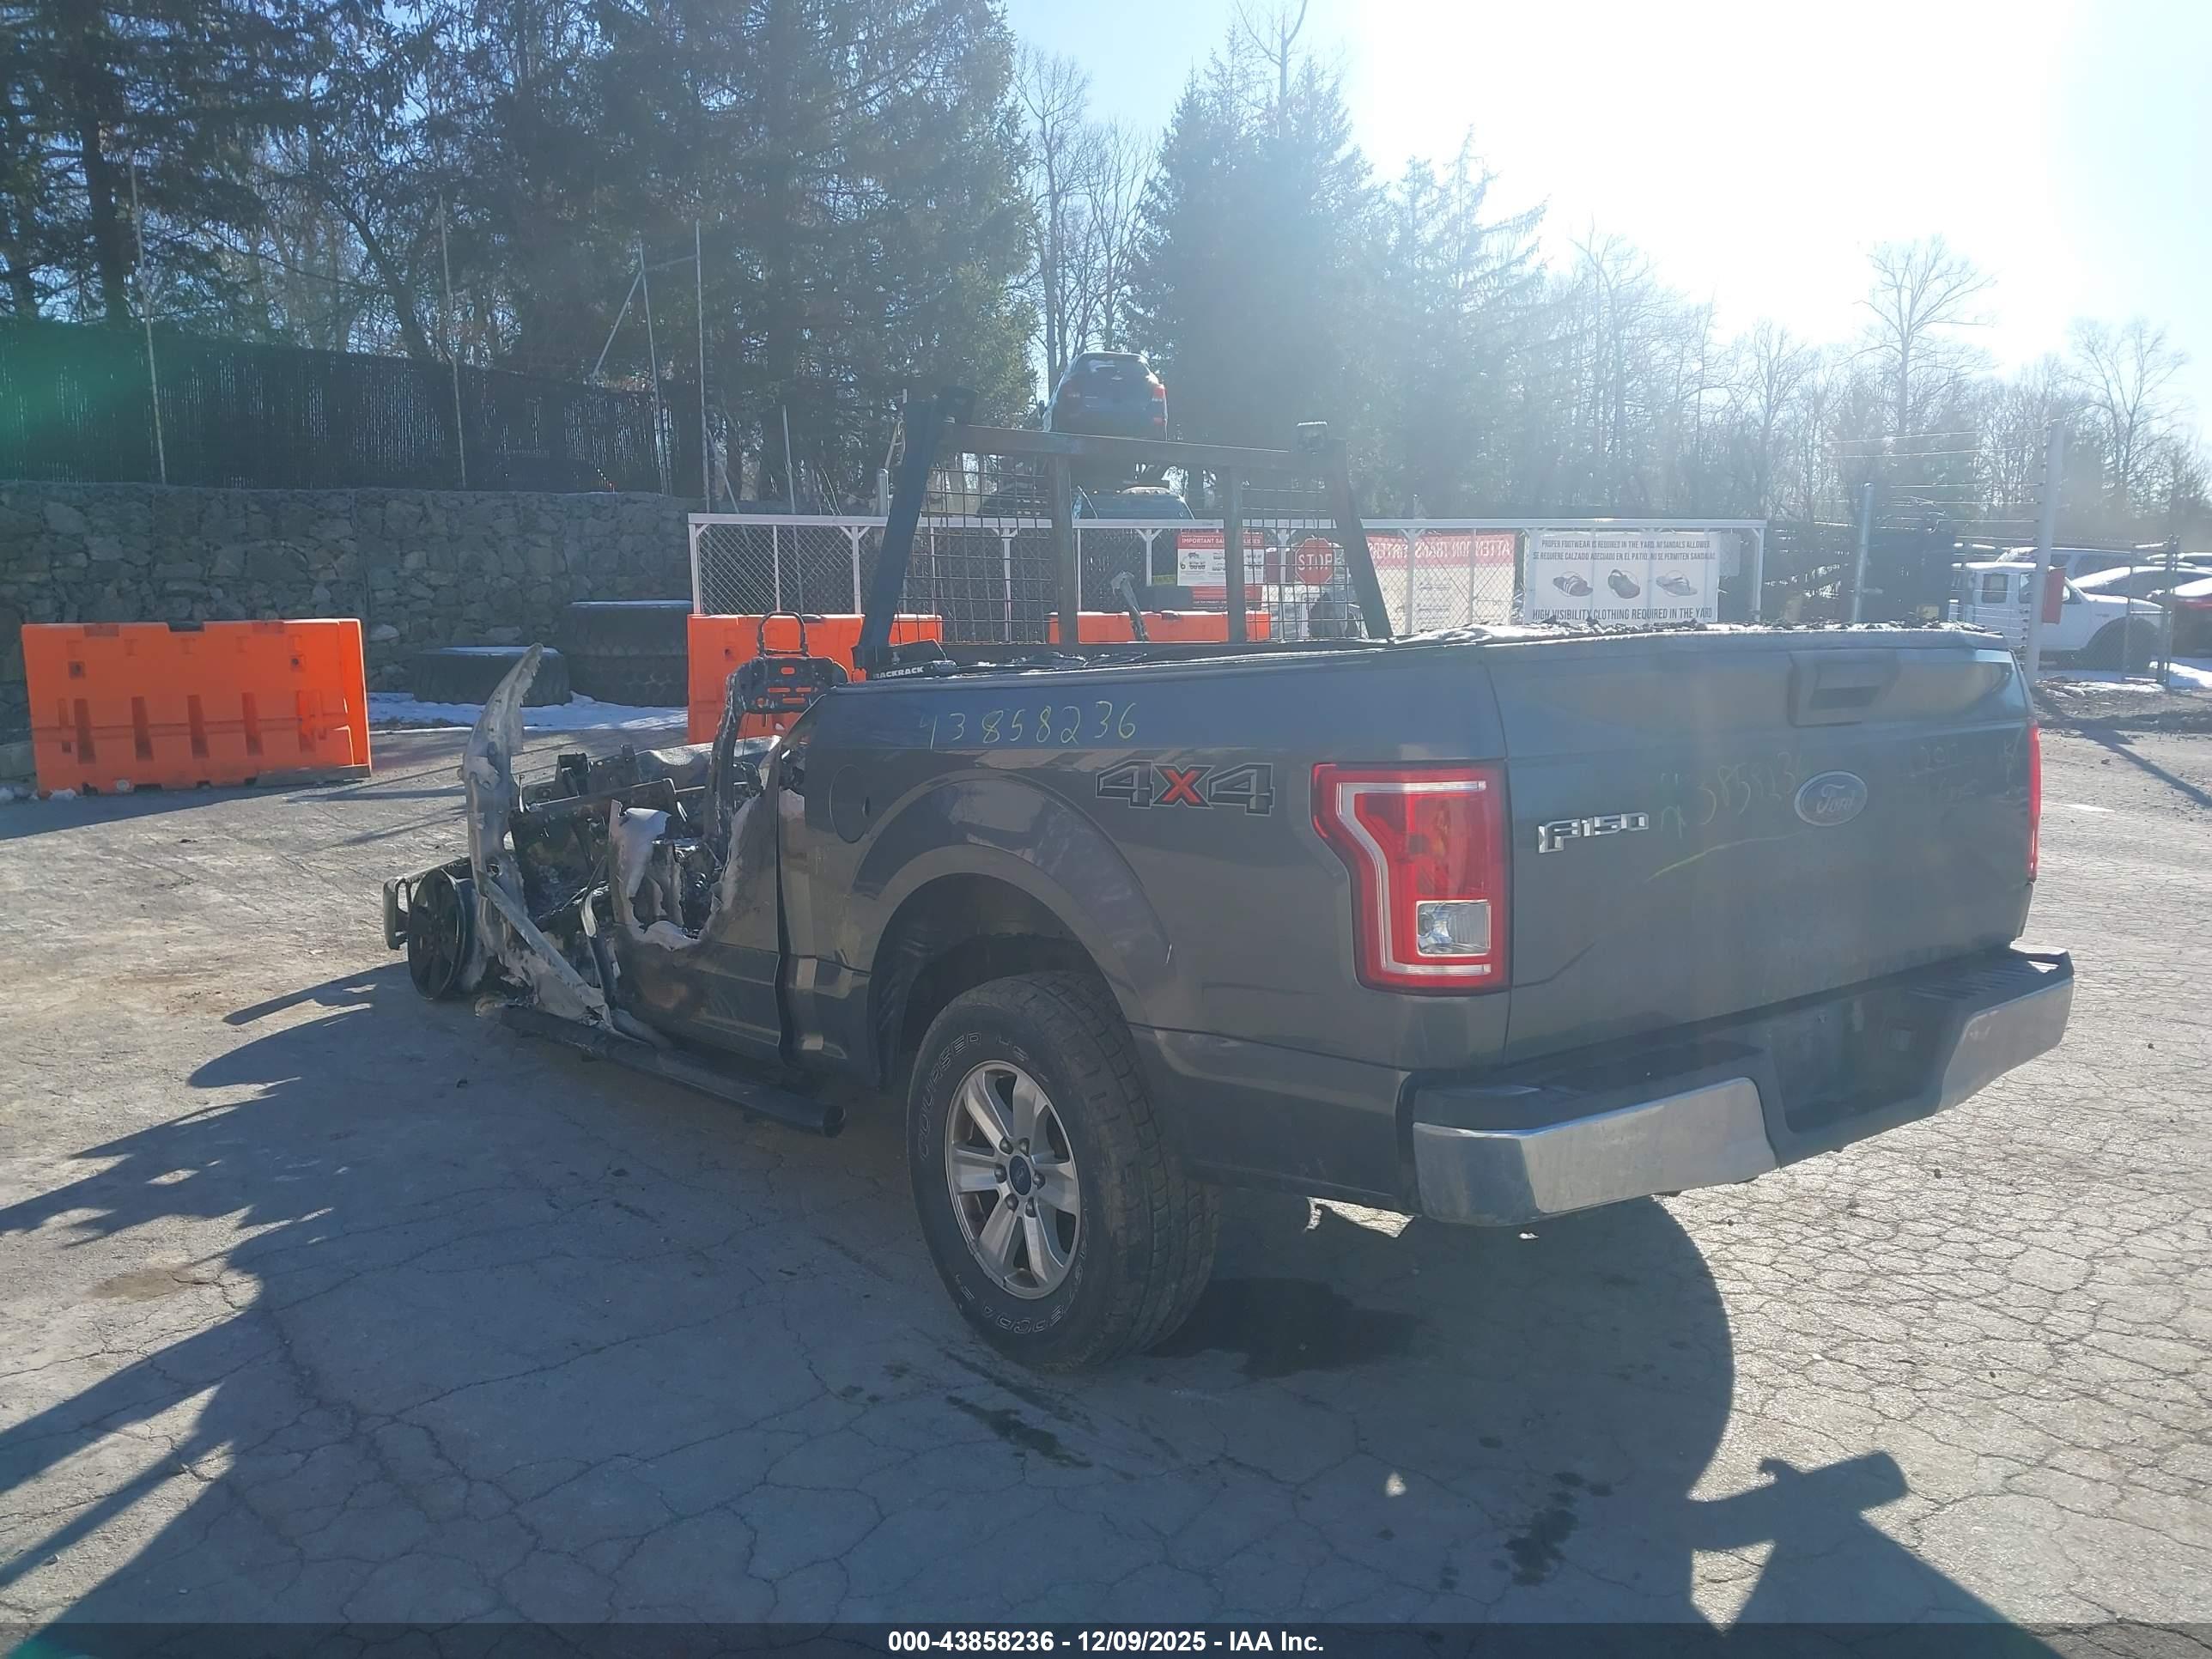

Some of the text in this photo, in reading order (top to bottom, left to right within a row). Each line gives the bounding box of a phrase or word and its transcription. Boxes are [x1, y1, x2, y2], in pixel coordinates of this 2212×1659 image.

[1598, 540, 1620, 549] REQUIRED
[1297, 553, 1333, 571] STOP
[1540, 551, 1564, 560] REQUIERE
[1565, 552, 1589, 561] CALZADO
[1616, 552, 1623, 561] EN
[1624, 552, 1630, 561] EL
[1533, 607, 1712, 620] HIGH VISIBILITY CLOTHING REQUIRED IN THE YARD
[873, 665, 925, 679] BACKRACK
[1815, 782, 1856, 815] Ford
